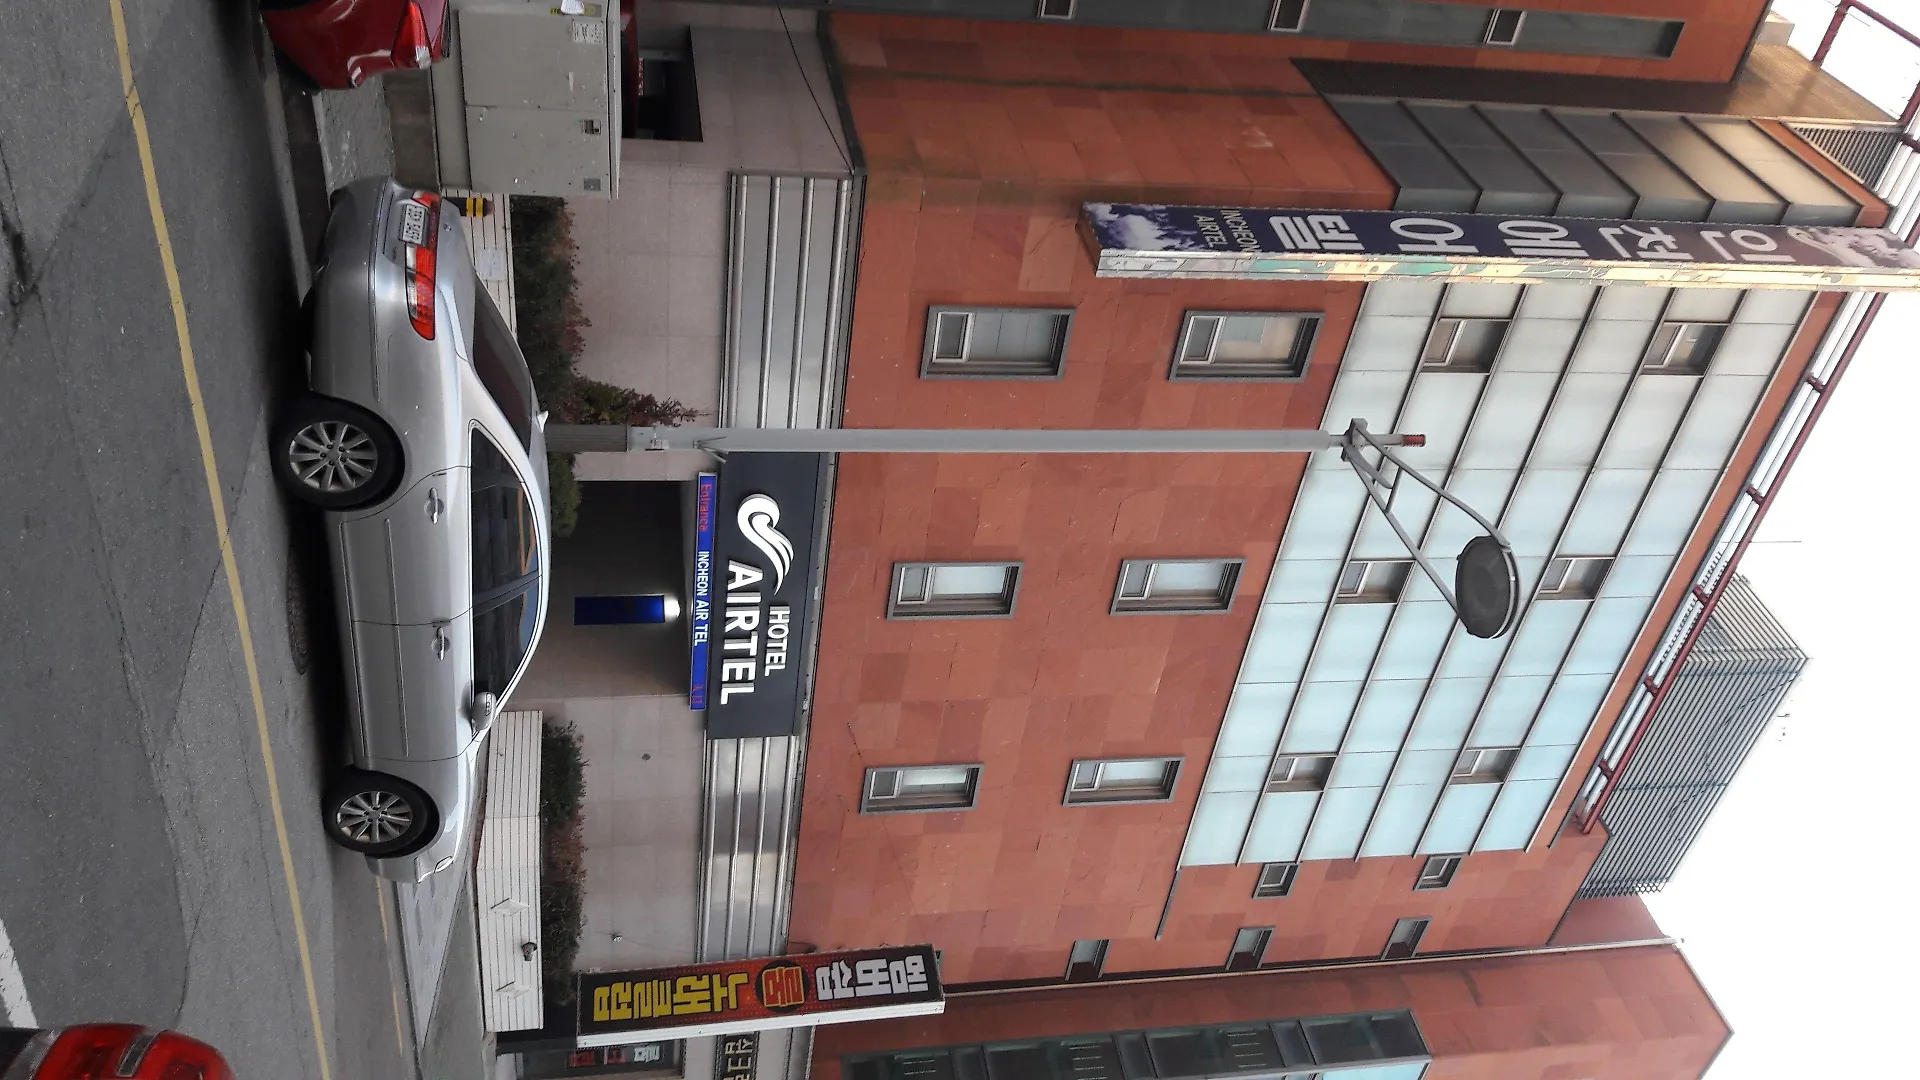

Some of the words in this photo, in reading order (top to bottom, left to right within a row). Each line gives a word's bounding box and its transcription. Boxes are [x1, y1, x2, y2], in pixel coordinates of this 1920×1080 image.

[1193, 214, 1228, 248] AIRTEL
[1219, 208, 1262, 252] INCHEON
[1268, 214, 1796, 262] 인천에어텔
[699, 484, 712, 532] Entrance
[696, 551, 710, 595] INCHEON
[695, 600, 709, 620] AIR
[694, 623, 708, 646] TEL
[720, 560, 763, 705] AIRTEL
[764, 605, 791, 676] HOTEL
[593, 973, 748, 1022] 노래클럽
[761, 966, 805, 1007] 룸
[815, 955, 929, 1000] 멤버쉽
